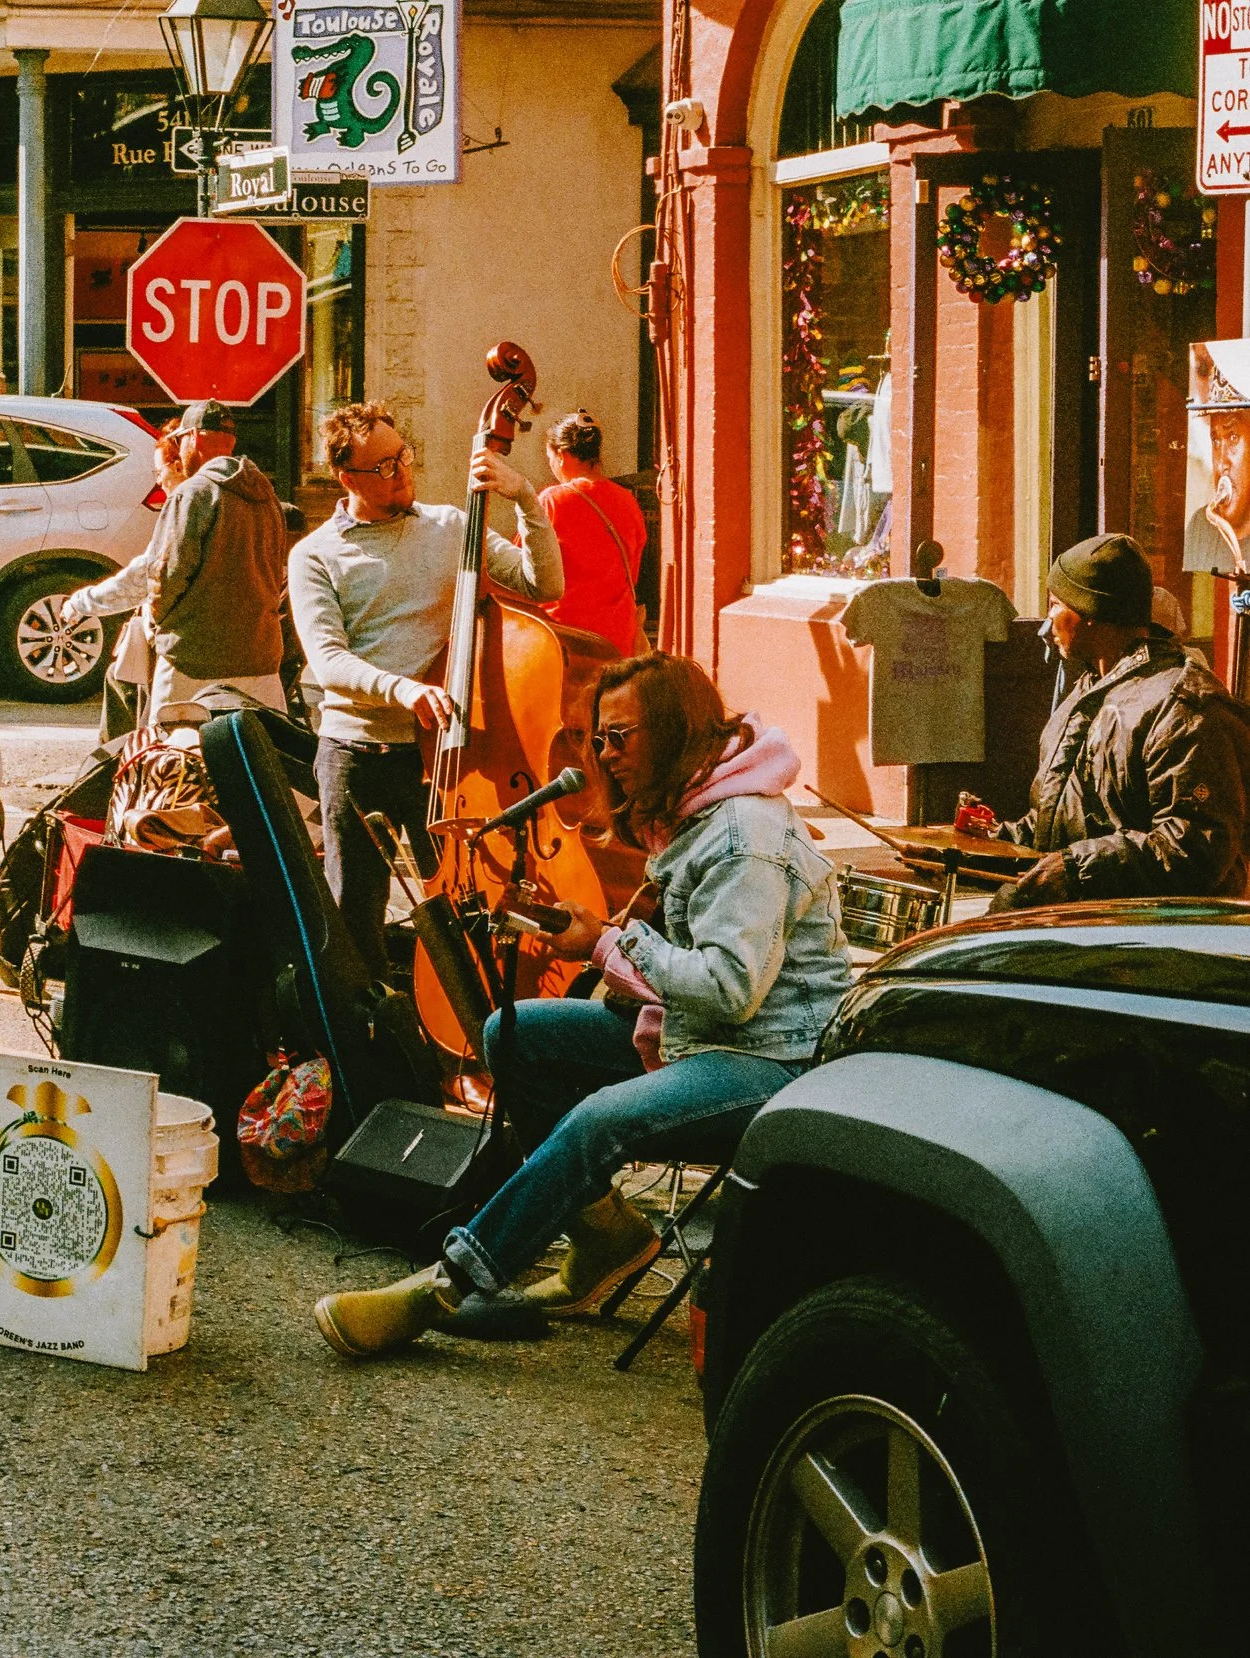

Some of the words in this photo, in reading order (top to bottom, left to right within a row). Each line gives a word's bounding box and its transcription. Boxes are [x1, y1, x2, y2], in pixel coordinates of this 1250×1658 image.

[297, 12, 399, 34] Toulouse
[1203, 2, 1231, 40] NO
[417, 12, 440, 128] Royale
[112, 143, 156, 165] Rue
[403, 161, 420, 174] To
[426, 160, 447, 173] Go
[230, 167, 274, 199] Royal
[254, 188, 366, 213] oulouse
[142, 277, 292, 346] STOP
[27, 1064, 49, 1074] Scan
[51, 1066, 72, 1079] Here
[35, 1341, 59, 1351] JAZZ
[60, 1340, 85, 1351] BAND
